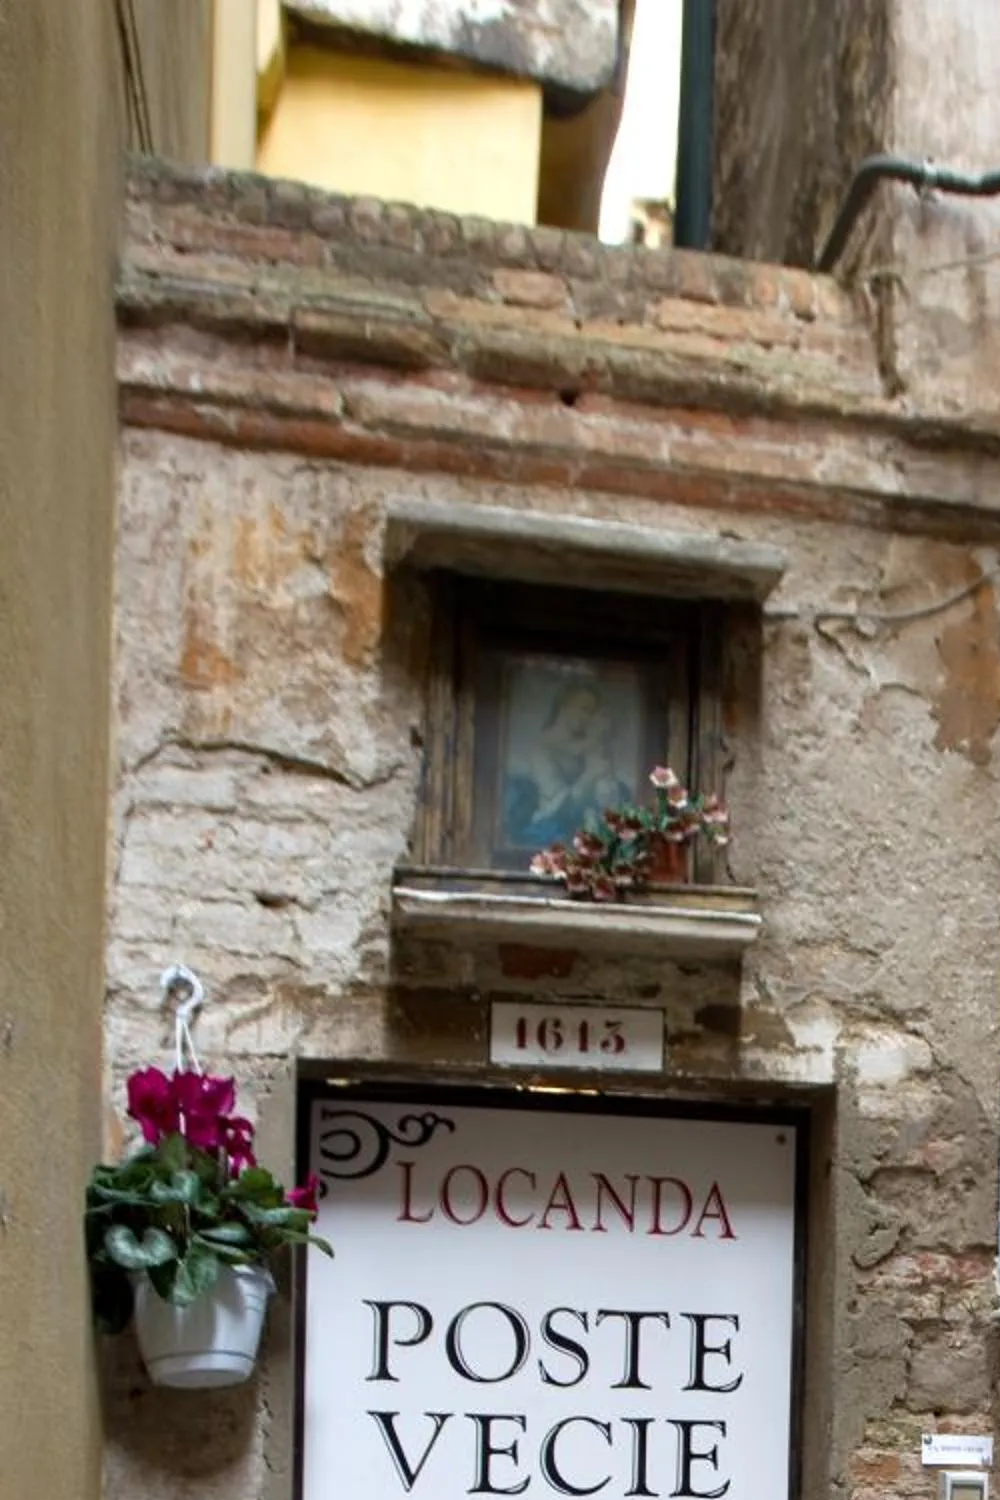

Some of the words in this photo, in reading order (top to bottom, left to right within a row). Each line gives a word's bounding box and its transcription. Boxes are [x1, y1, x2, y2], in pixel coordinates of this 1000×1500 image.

[395, 1161, 738, 1240] LOCANDA
[362, 1299, 744, 1393] POSTE
[366, 1410, 732, 1500] VECIE
